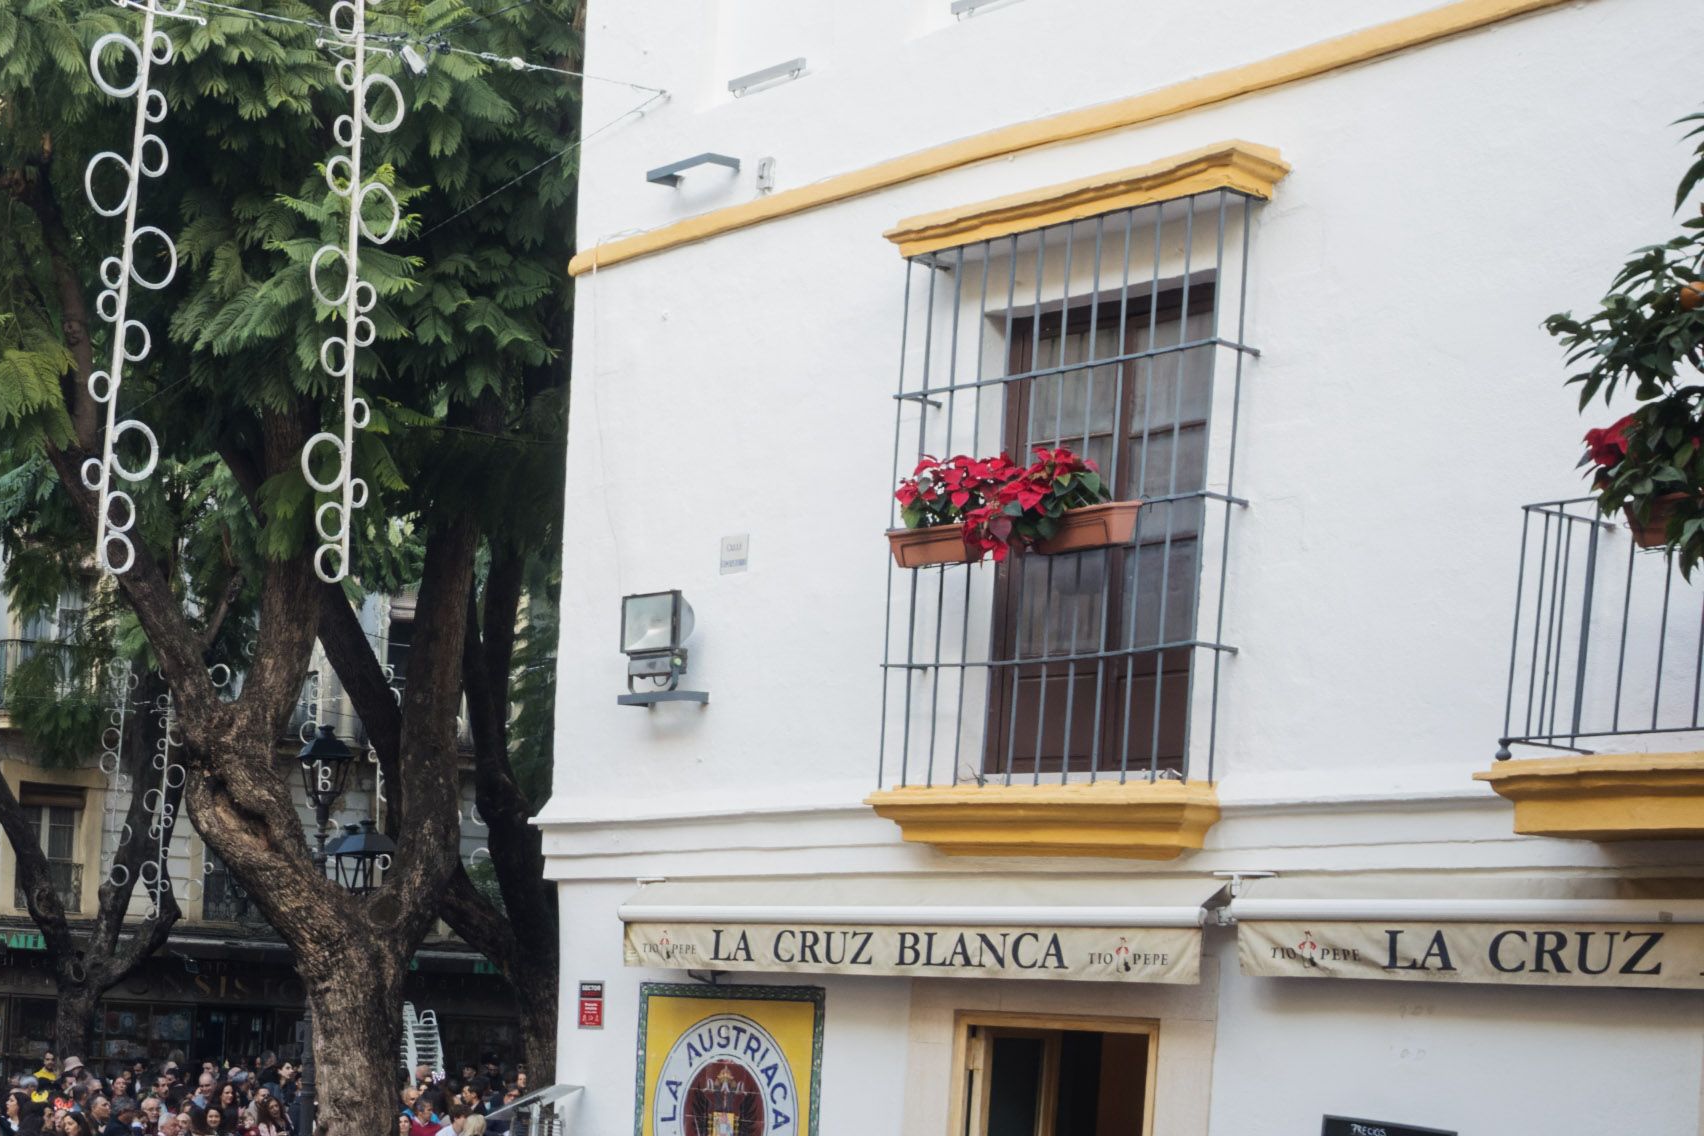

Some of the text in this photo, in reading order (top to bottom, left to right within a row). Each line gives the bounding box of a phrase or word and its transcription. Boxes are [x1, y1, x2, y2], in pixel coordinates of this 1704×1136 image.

[642, 943, 696, 955] TIO PEPE
[710, 929, 1069, 969] LA CRUZ BLANCA
[1088, 952, 1168, 966] TIO PEPE
[1271, 946, 1360, 962] TIO PEPE
[1383, 929, 1664, 975] LA CRUZ
[661, 1025, 791, 1130] LA AUSTRIACA
